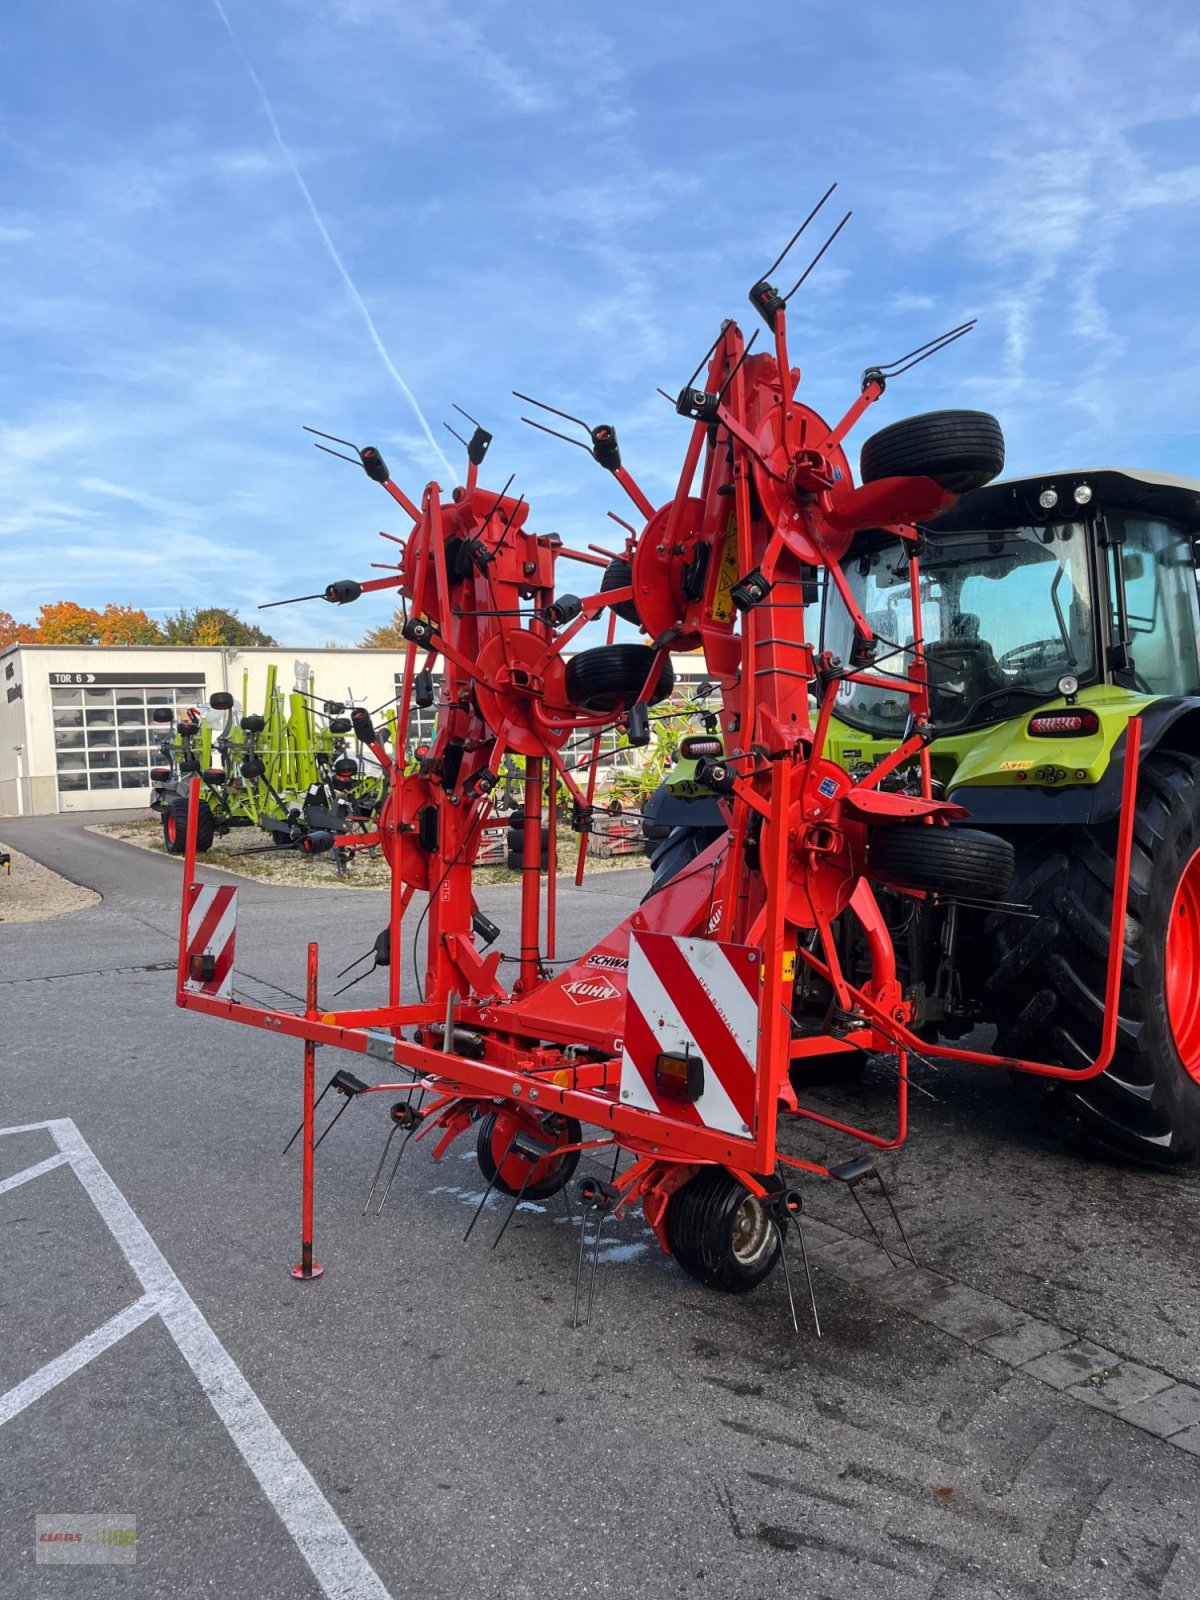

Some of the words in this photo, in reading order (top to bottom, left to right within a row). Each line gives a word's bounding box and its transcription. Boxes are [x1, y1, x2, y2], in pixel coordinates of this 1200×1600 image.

[55, 674, 71, 683] TOR
[76, 674, 82, 683] 6
[567, 982, 615, 999] KUHN
